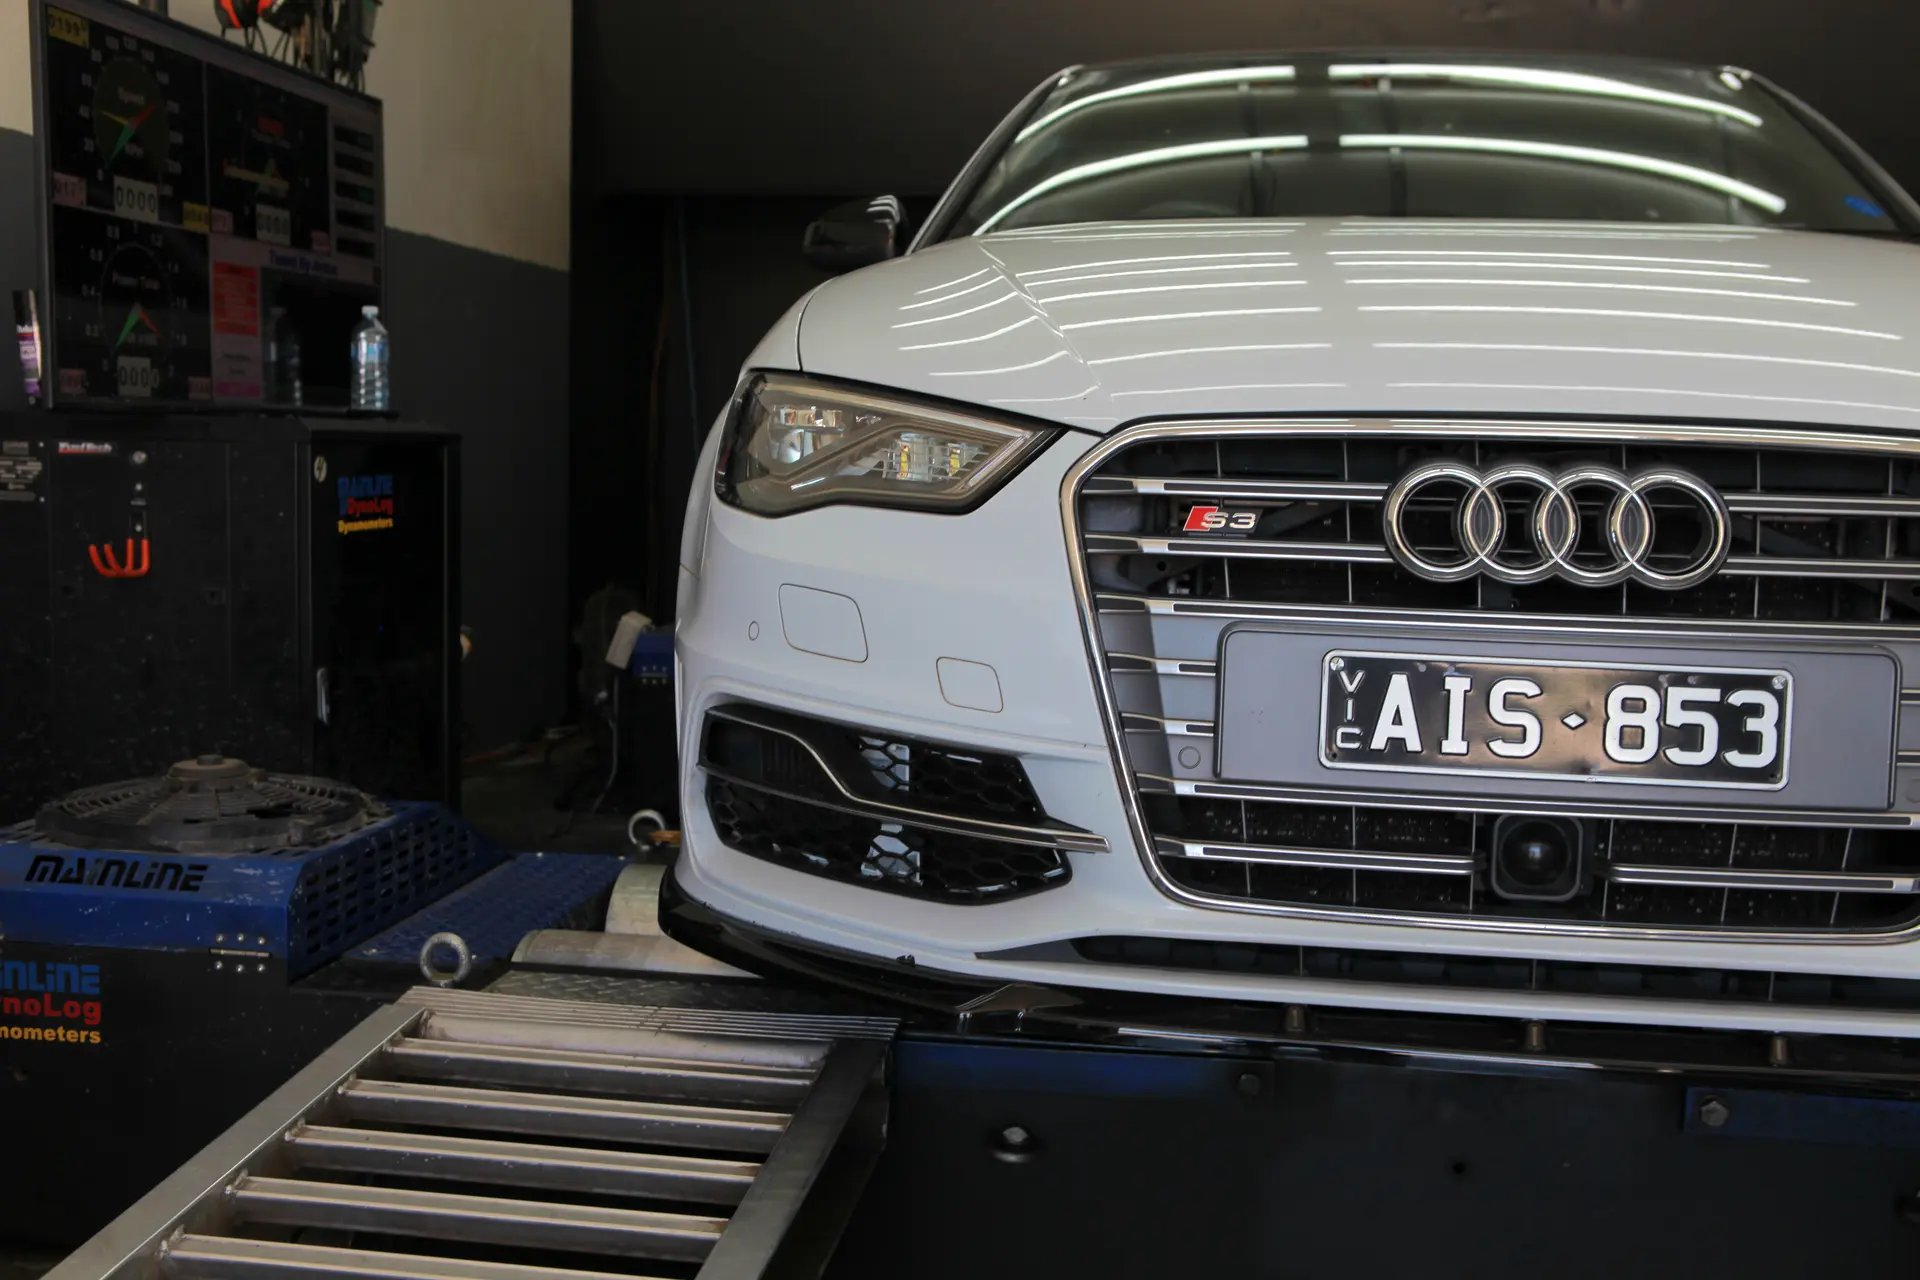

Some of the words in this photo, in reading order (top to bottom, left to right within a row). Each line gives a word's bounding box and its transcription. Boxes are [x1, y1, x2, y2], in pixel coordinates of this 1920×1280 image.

[1201, 512, 1257, 529] S3
[1336, 669, 1365, 750] VIC
[1604, 682, 1780, 769] 853
[0, 992, 102, 1026] noLog
